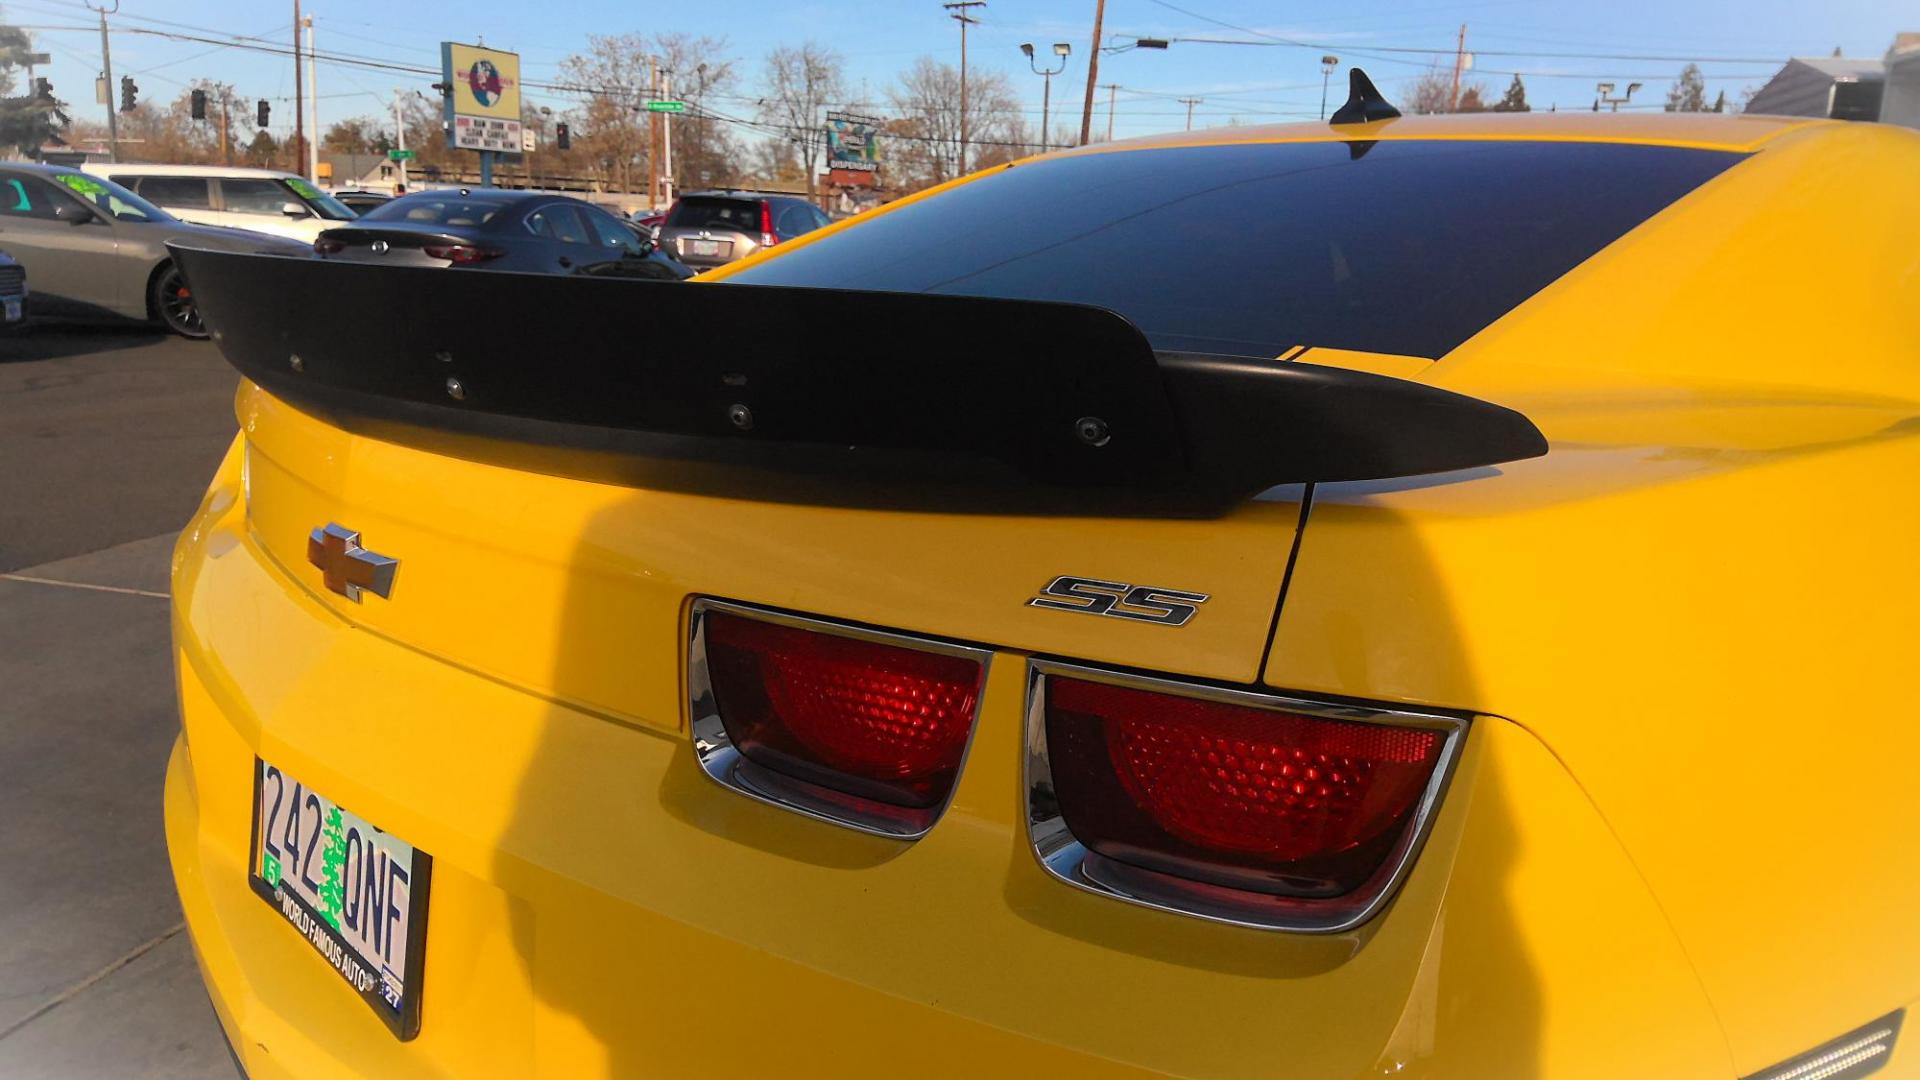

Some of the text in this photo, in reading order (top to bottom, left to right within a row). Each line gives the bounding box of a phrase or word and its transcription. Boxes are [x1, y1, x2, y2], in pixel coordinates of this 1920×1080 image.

[1025, 575, 1210, 627] SS
[265, 767, 408, 963] 242 QNF
[266, 861, 277, 882] 5
[281, 893, 367, 992] WORLD FAMOUS AUTO
[385, 985, 400, 1009] 27
